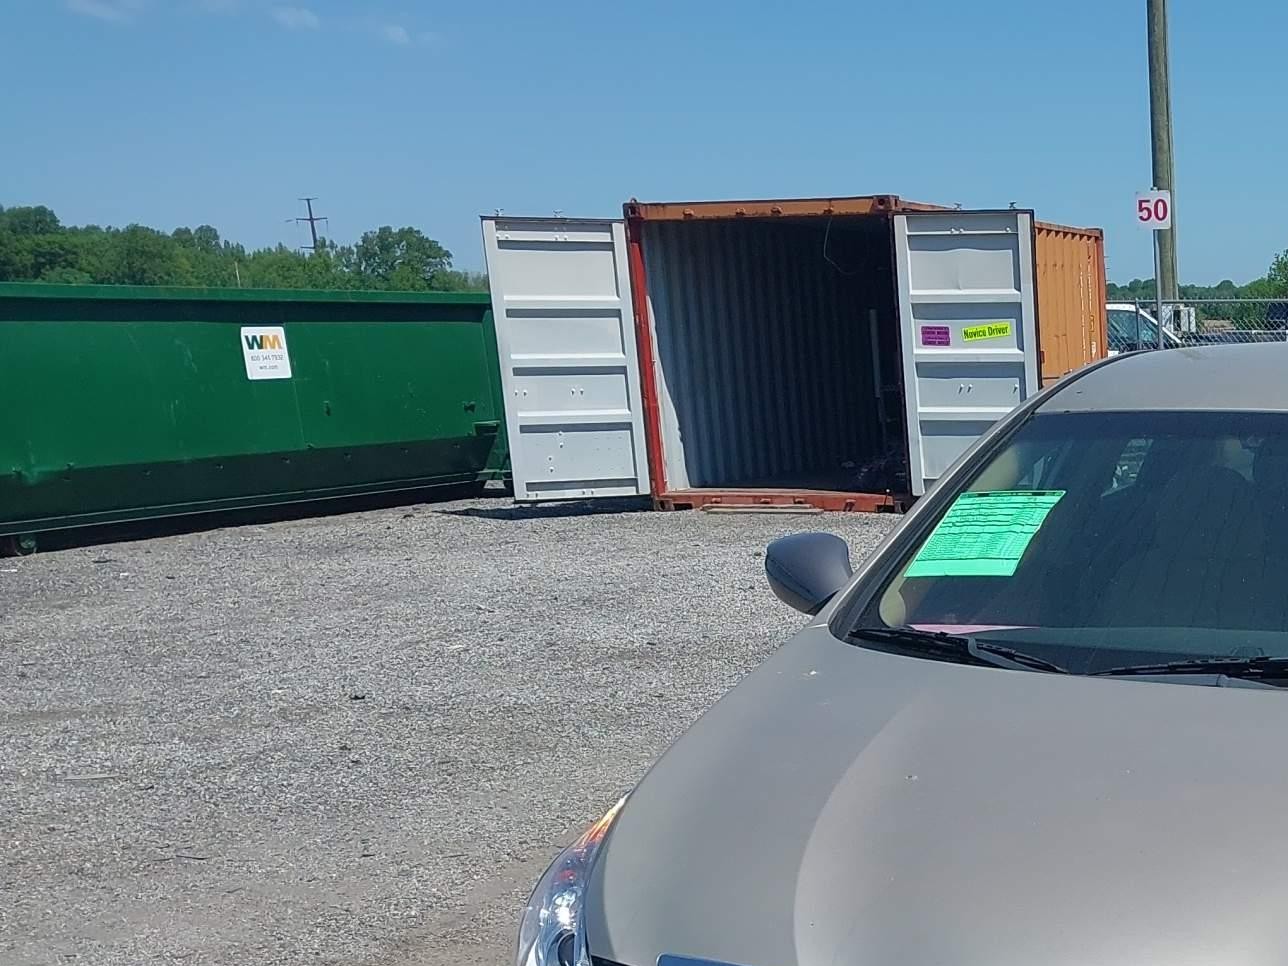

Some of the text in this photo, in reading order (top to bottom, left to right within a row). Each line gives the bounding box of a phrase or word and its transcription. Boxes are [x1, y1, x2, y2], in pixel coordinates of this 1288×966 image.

[1138, 199, 1167, 221] 50
[963, 327, 987, 339] Novice
[988, 325, 1009, 336] Driver
[244, 335, 283, 350] WM
